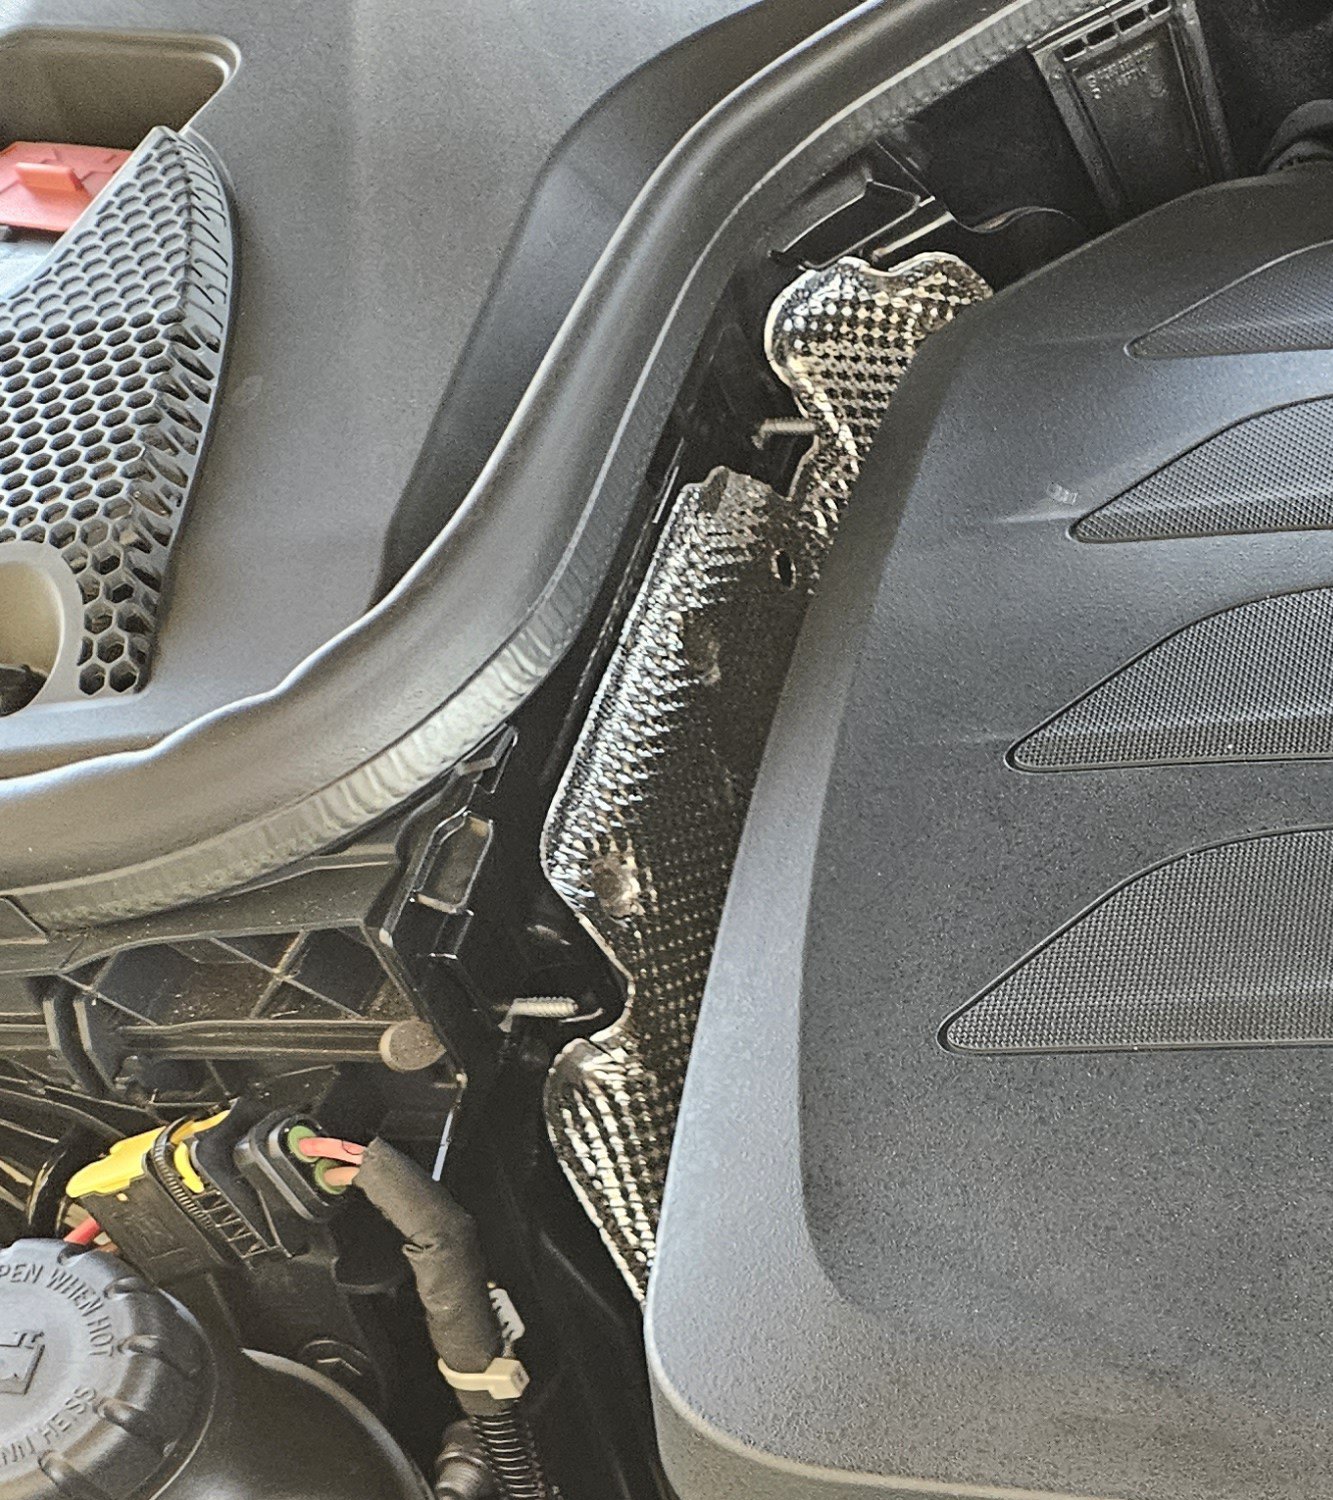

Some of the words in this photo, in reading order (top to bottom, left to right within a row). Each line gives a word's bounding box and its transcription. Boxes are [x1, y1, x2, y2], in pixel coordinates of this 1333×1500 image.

[46, 1267, 105, 1317] WHEN
[86, 1314, 115, 1357] HOT
[40, 1385, 98, 1445] HEISS
